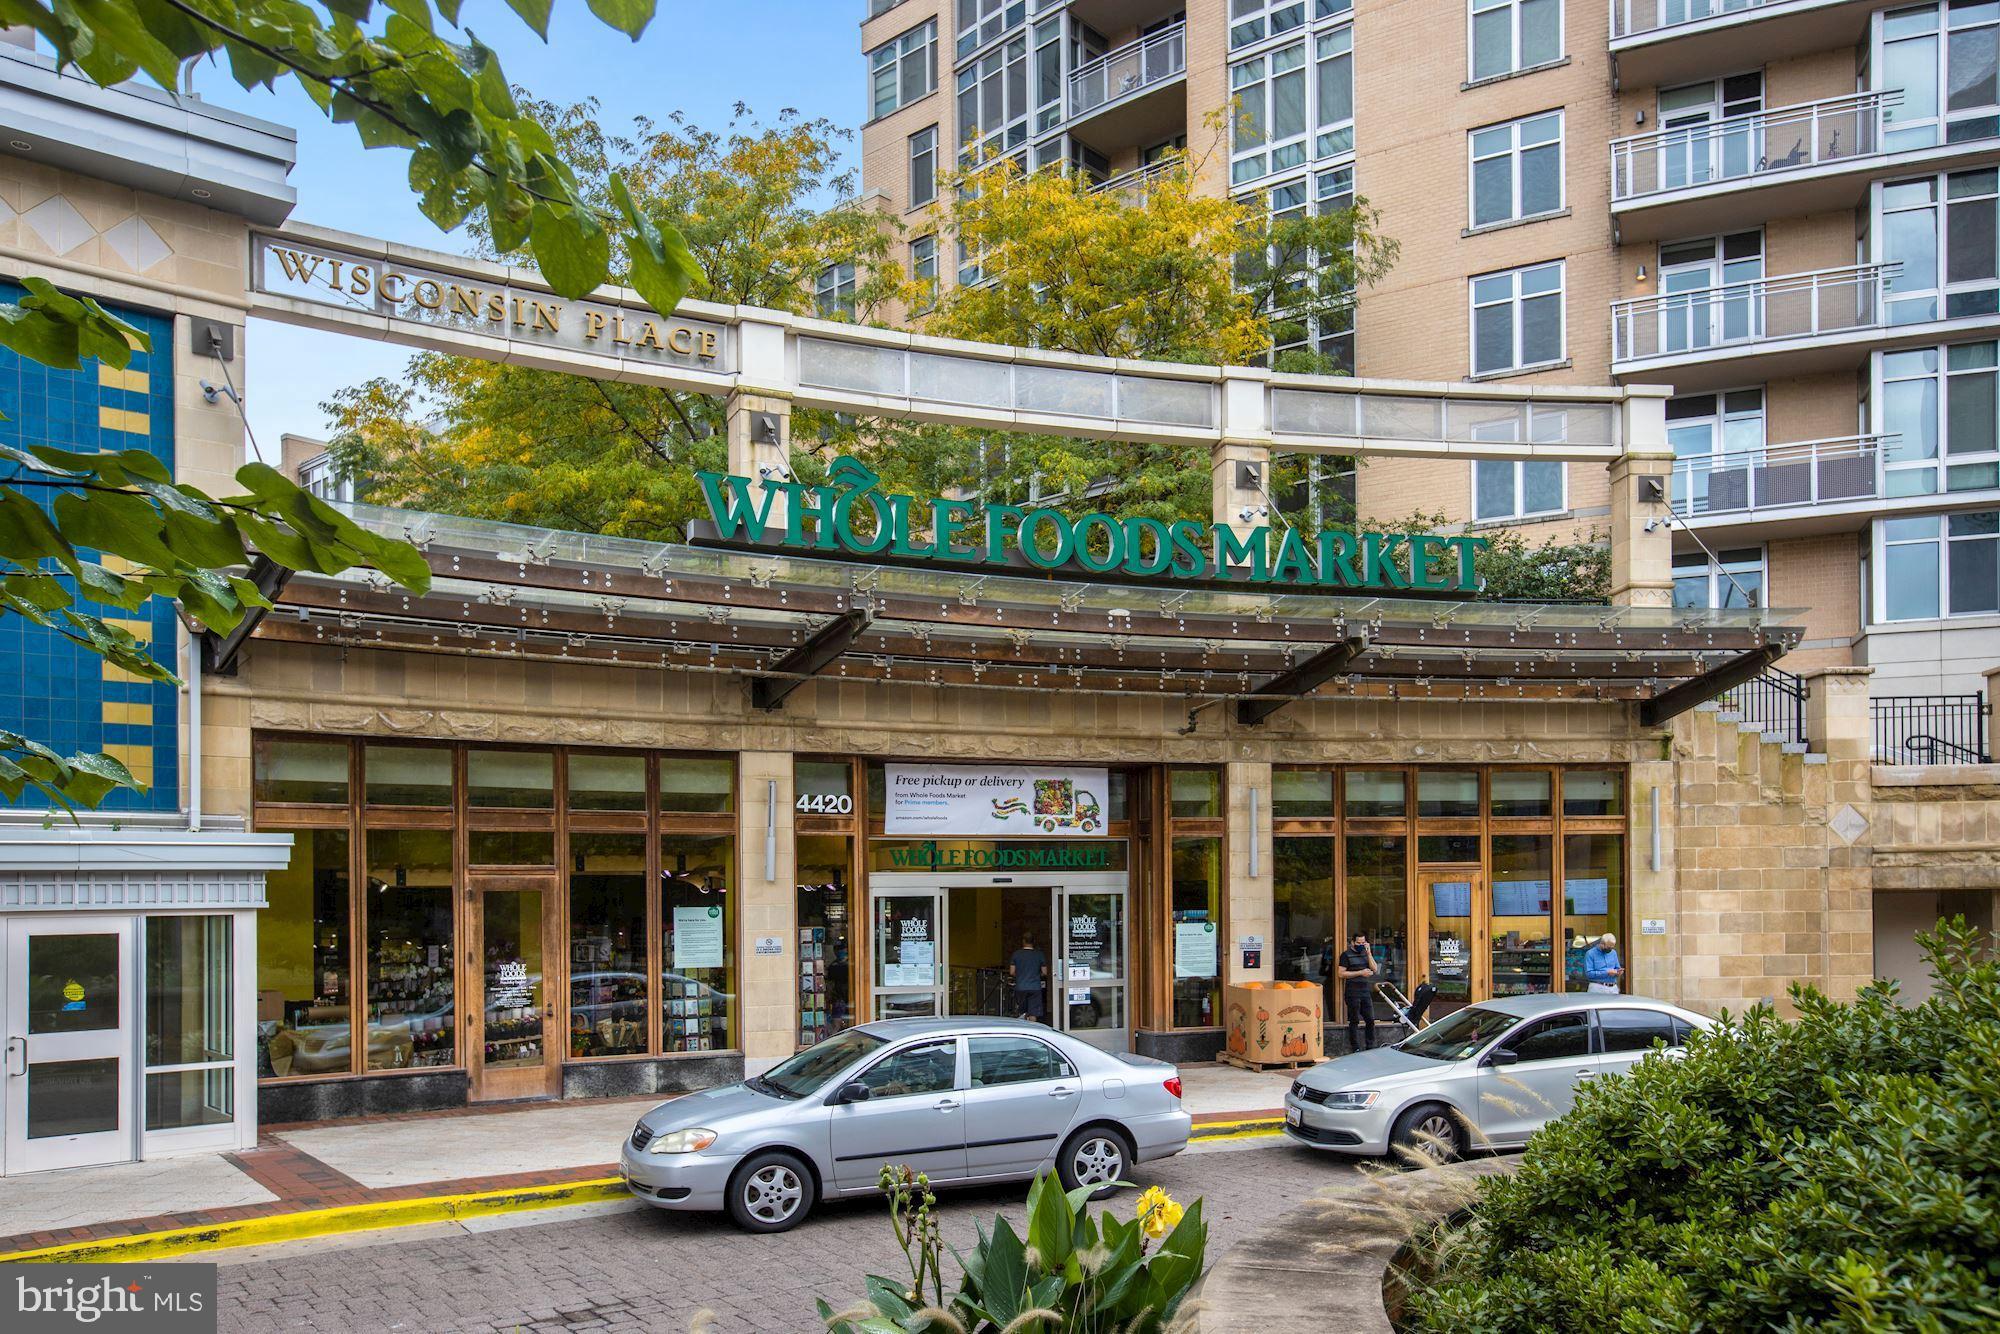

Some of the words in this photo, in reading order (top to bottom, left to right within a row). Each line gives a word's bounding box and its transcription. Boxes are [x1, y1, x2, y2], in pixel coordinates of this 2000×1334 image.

[271, 245, 562, 333] WISCONSIN
[585, 311, 720, 358] PLACE
[695, 470, 976, 560] WHOLE
[985, 503, 1206, 578] FOODS
[1211, 523, 1489, 593] MARKET
[895, 774, 920, 786] Free
[923, 775, 962, 789] pickup
[964, 779, 978, 787] or
[980, 776, 1025, 789] delivery
[796, 794, 852, 814] 4420
[889, 848, 962, 867] WHOLE
[964, 848, 1027, 867] FOODS
[1029, 847, 1107, 867] MARKET
[900, 919, 928, 927] WHOLE
[902, 926, 927, 934] FOODS
[500, 963, 527, 972] WHOLE
